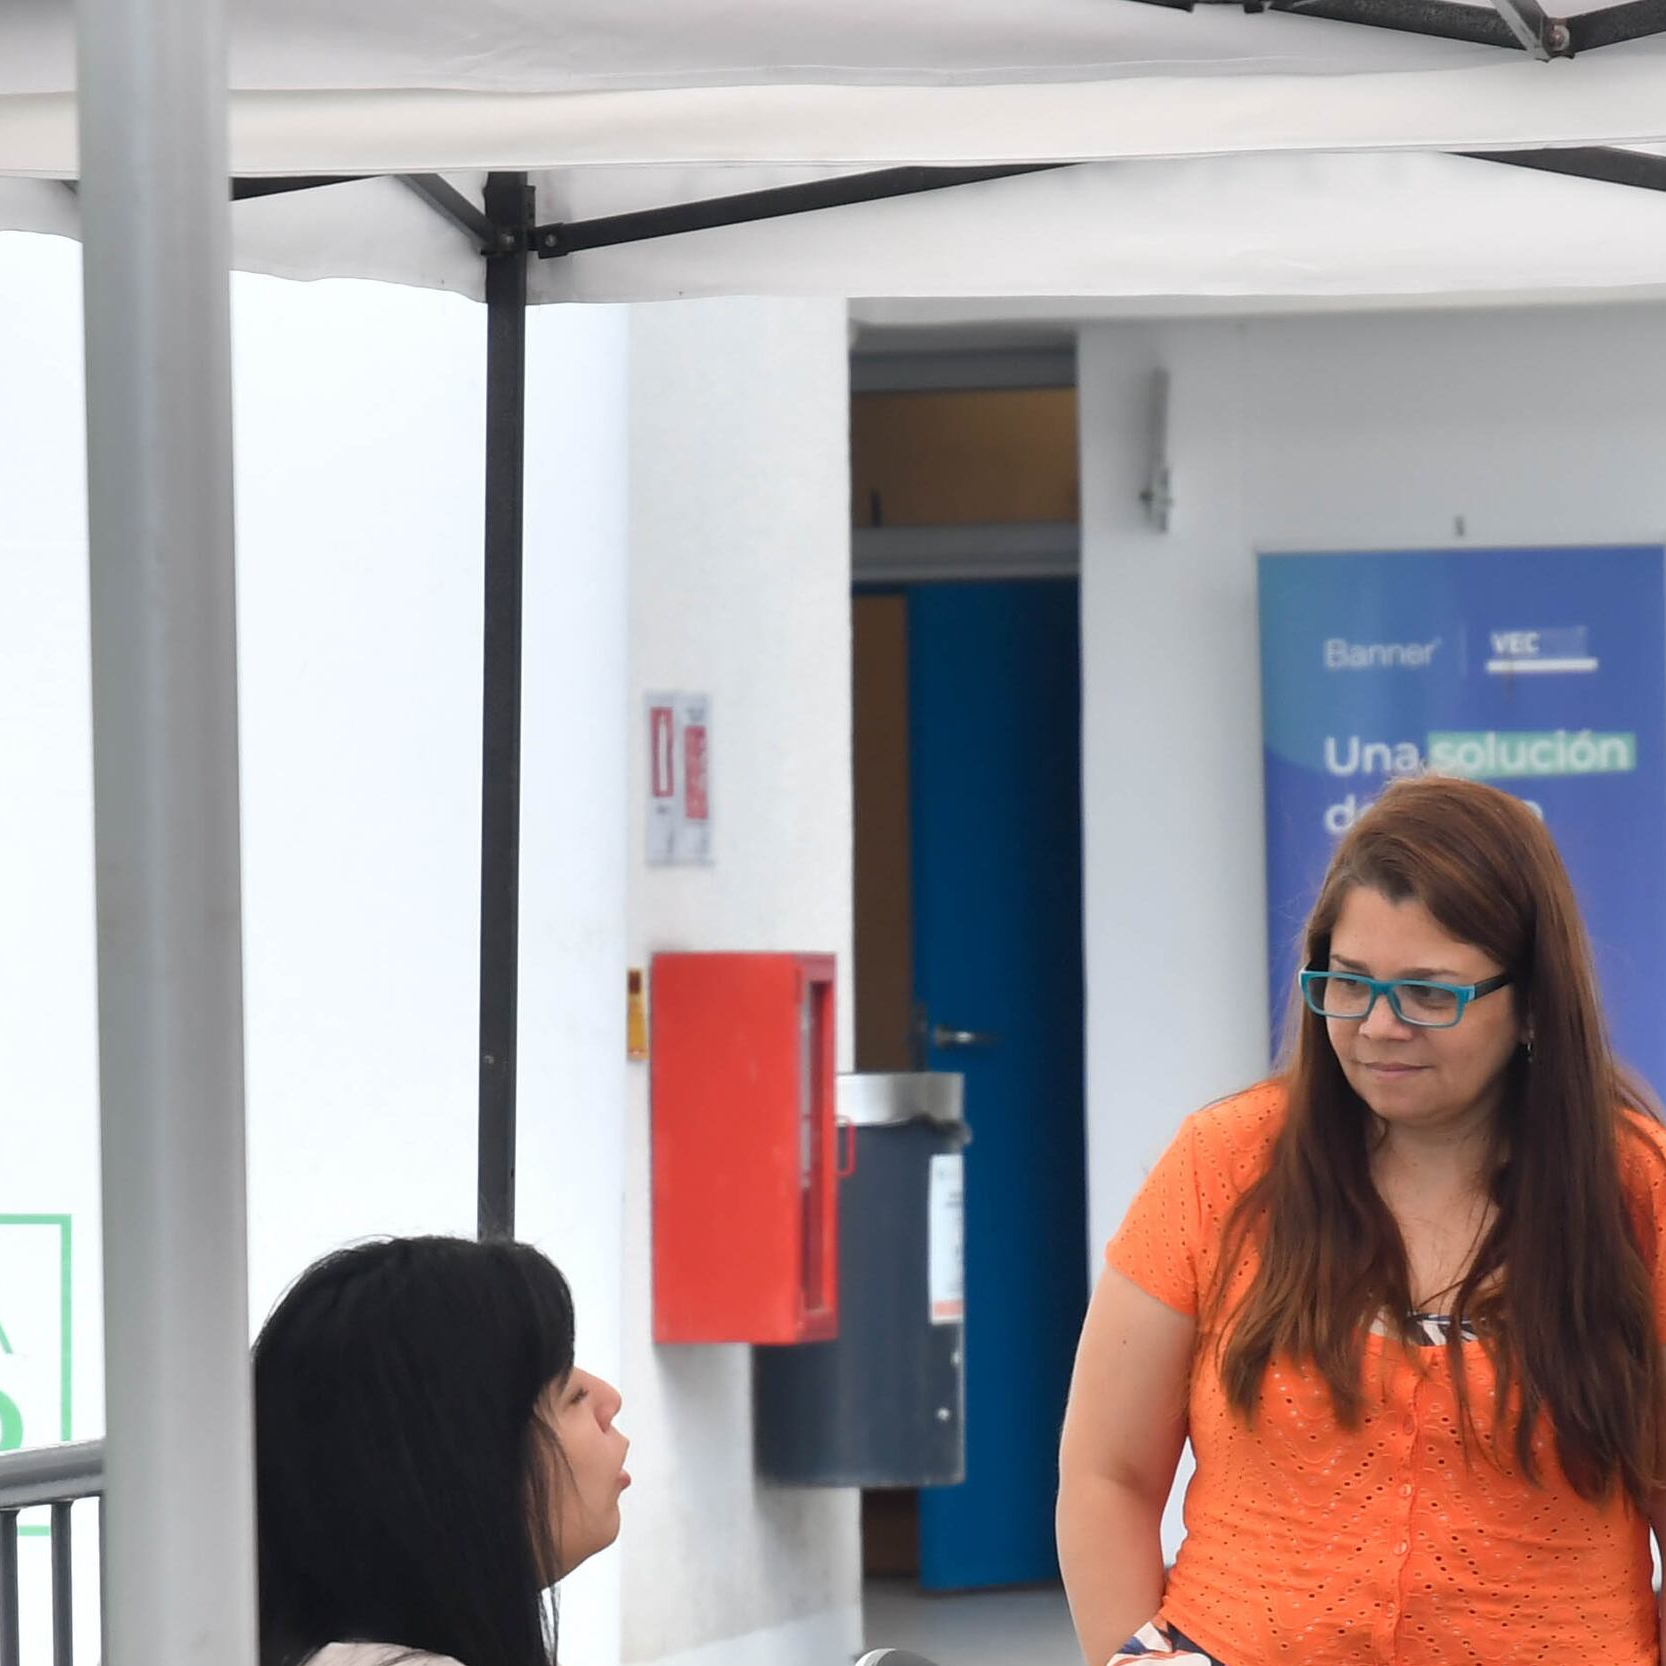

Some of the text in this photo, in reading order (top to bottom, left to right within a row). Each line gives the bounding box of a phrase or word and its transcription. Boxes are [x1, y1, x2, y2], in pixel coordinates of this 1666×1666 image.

[1324, 637, 1440, 669] Banner
[1324, 737, 1423, 776] Una
[1429, 728, 1631, 773] solución
